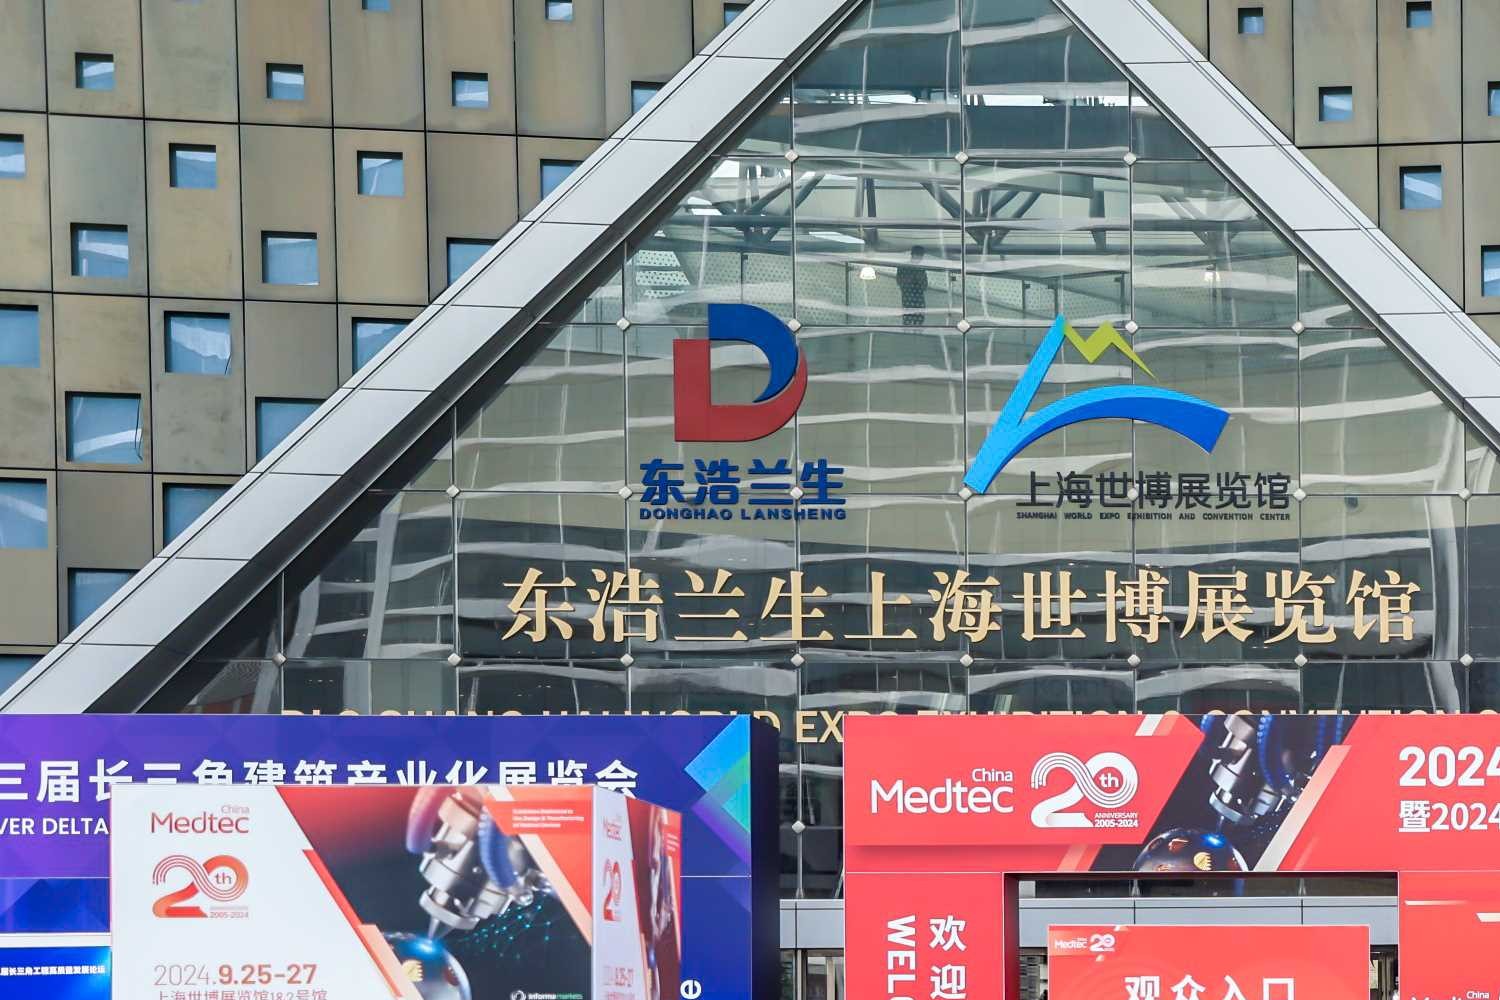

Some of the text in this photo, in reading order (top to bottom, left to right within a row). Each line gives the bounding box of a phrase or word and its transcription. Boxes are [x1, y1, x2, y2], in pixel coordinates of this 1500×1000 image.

[640, 458, 846, 504] 东浩兰生
[1015, 470, 1292, 509] 上海世博展览馆
[640, 508, 846, 520] DONGHAO LANSHENG
[1016, 512, 1057, 520] SHANGHAI
[1064, 512, 1093, 520] WORLD
[1100, 512, 1121, 520] EXPO
[1179, 512, 1196, 520] AND
[1202, 512, 1254, 520] CONVENTION
[1260, 512, 1291, 520] CENTER
[501, 567, 1421, 644] 东浩兰生上海世博展览馆
[972, 768, 1014, 783] China
[871, 779, 1014, 814] Medtec
[221, 805, 250, 814] China
[42, 817, 109, 835] DELTA
[151, 811, 250, 834] Medtec
[1094, 819, 1138, 828] 2005-2024
[153, 963, 318, 986] 2024.9.25-27
[1466, 991, 1490, 999] China
